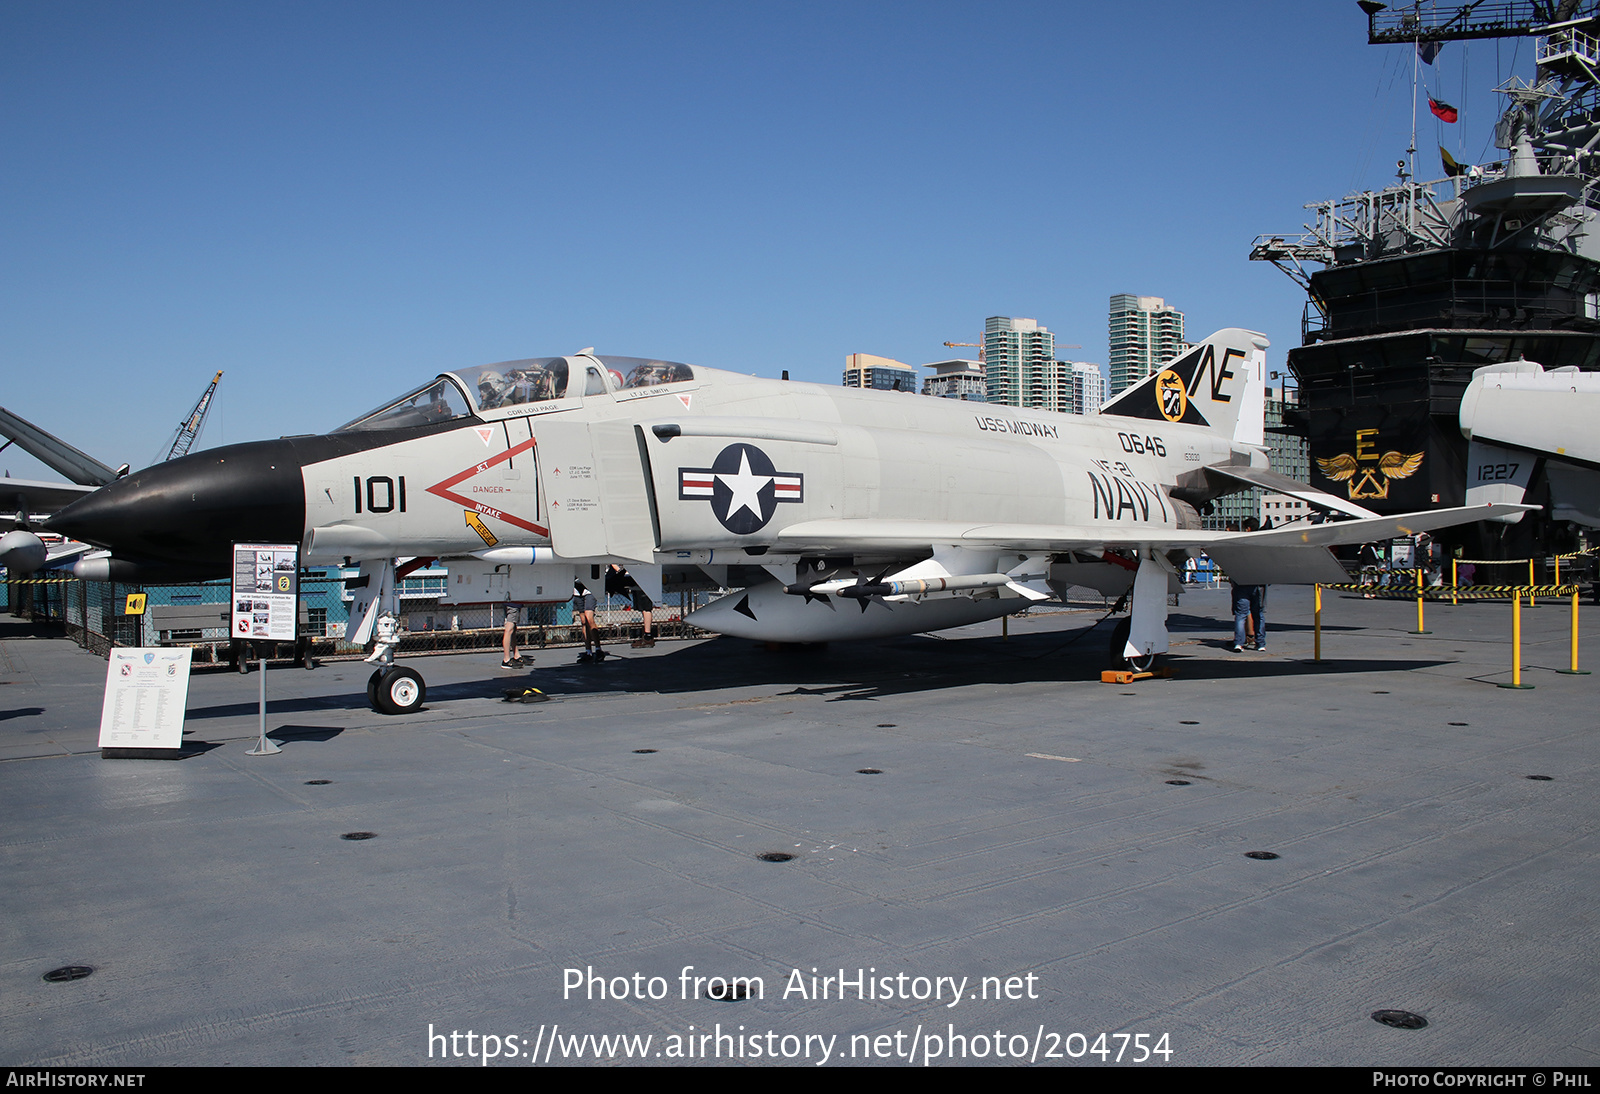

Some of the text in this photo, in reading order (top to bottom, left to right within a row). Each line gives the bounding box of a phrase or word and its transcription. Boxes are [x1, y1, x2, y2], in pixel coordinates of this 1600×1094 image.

[1188, 344, 1246, 403] NE
[524, 406, 539, 414] LOU
[540, 404, 560, 412] PAGE
[974, 416, 1059, 438] USS MIDWAY
[1118, 432, 1167, 458] 0646
[1356, 429, 1379, 460] E
[476, 462, 489, 474] JET
[1090, 458, 1135, 478] VF-21
[1478, 463, 1520, 480] 1227
[354, 476, 406, 514] 101
[1087, 471, 1168, 523] NAVY
[474, 504, 502, 518] INTAKE
[475, 523, 494, 544] RESCUE
